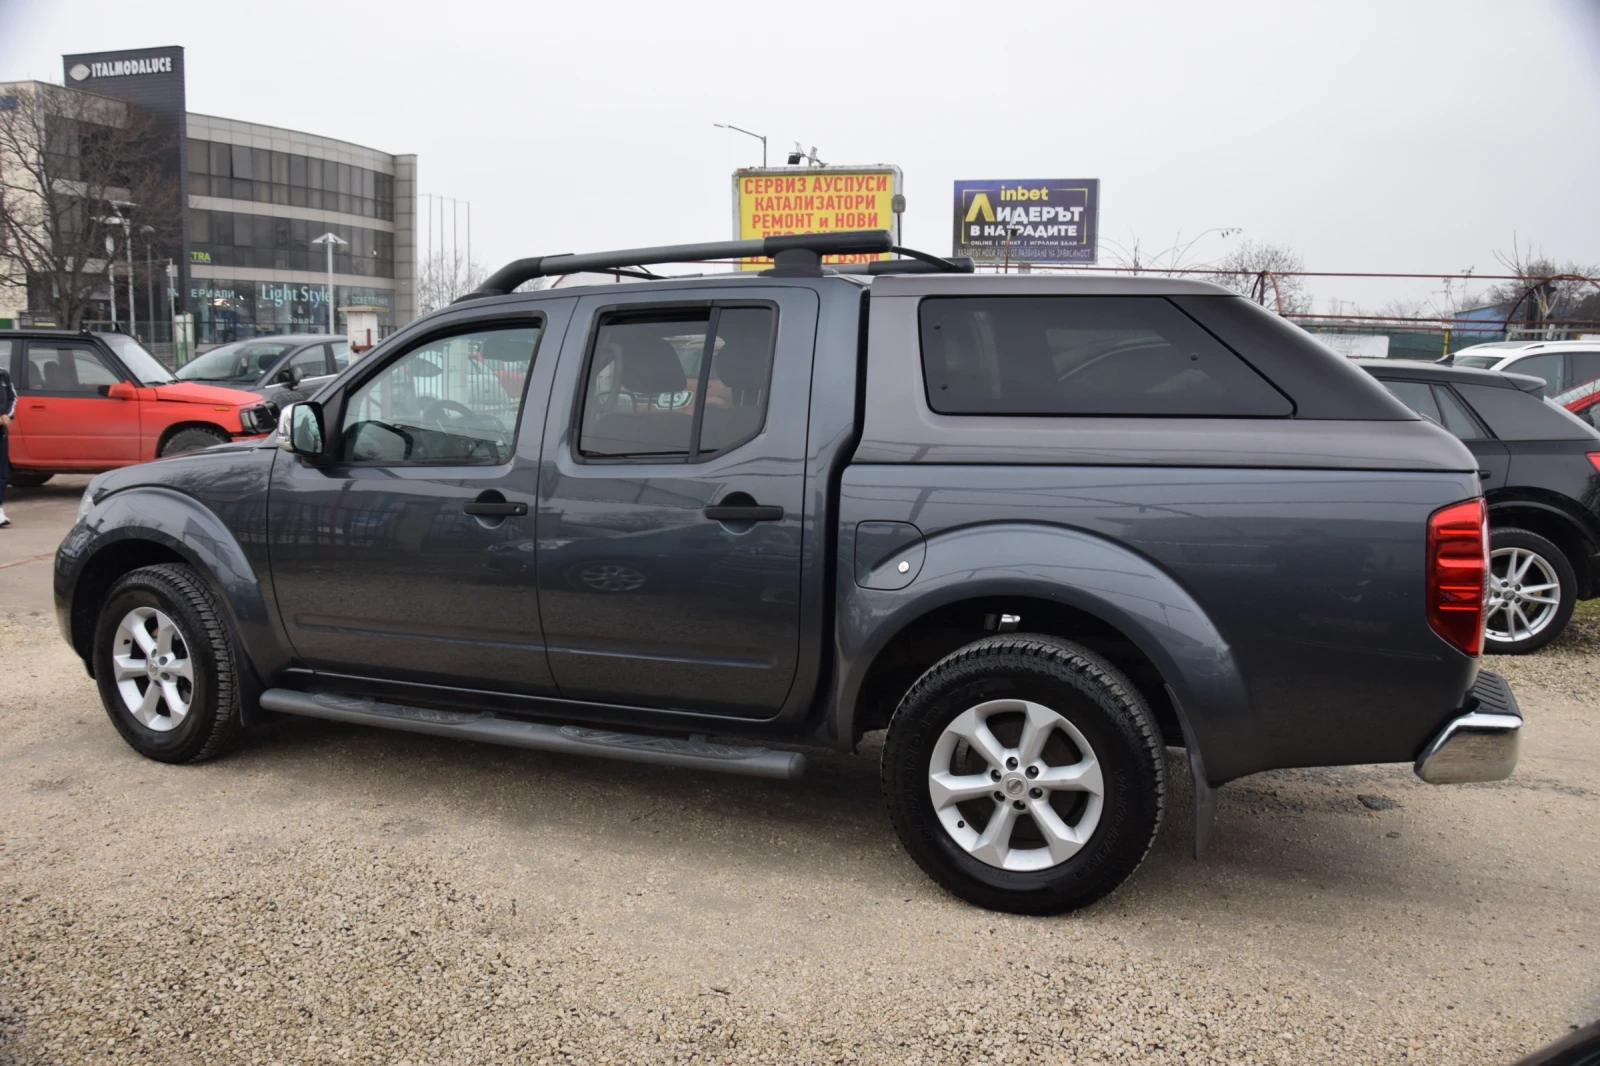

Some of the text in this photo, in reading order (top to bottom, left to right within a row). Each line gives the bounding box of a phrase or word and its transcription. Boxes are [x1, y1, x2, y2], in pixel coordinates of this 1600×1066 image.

[91, 57, 172, 78] ITALMODALUCE
[744, 175, 888, 195] СЕРВИЗ АУСПУСИ
[1000, 185, 1049, 201] inbet
[754, 195, 876, 212] КАТАЛИЗАТОРИ
[752, 213, 814, 229] РЕМОНТ
[835, 212, 879, 228] НОВИ
[970, 225, 981, 236] В
[190, 252, 211, 261] TRA
[261, 284, 331, 308] Light Style
[287, 315, 315, 324] Sound
